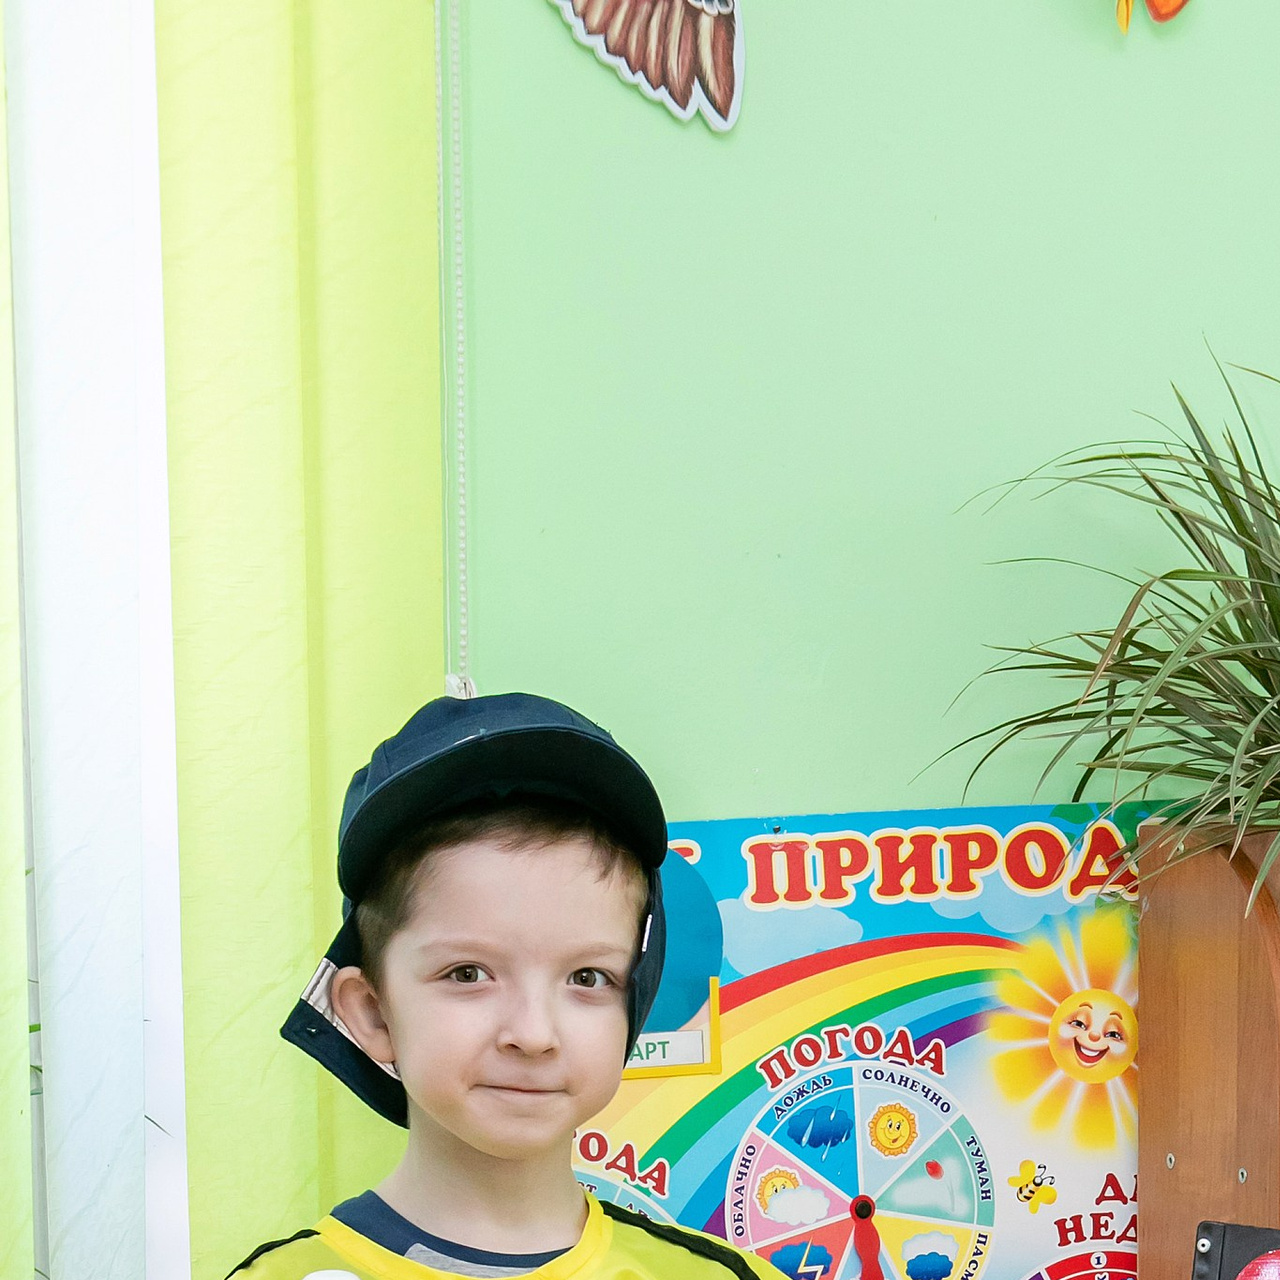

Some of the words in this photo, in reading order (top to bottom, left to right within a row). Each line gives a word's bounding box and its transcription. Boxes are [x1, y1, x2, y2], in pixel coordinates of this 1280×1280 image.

[629, 1040, 670, 1062] АРТ
[759, 1025, 945, 1089] ПОГОДА
[773, 1074, 833, 1119] ДОЖДЬ
[862, 1068, 952, 1115] СОЛНЕЧНО
[573, 1131, 668, 1196] ОДА
[734, 1144, 756, 1237] ОБЛАЧНО
[966, 1136, 992, 1201] ТУМАН
[1094, 1255, 1103, 1266] 1
